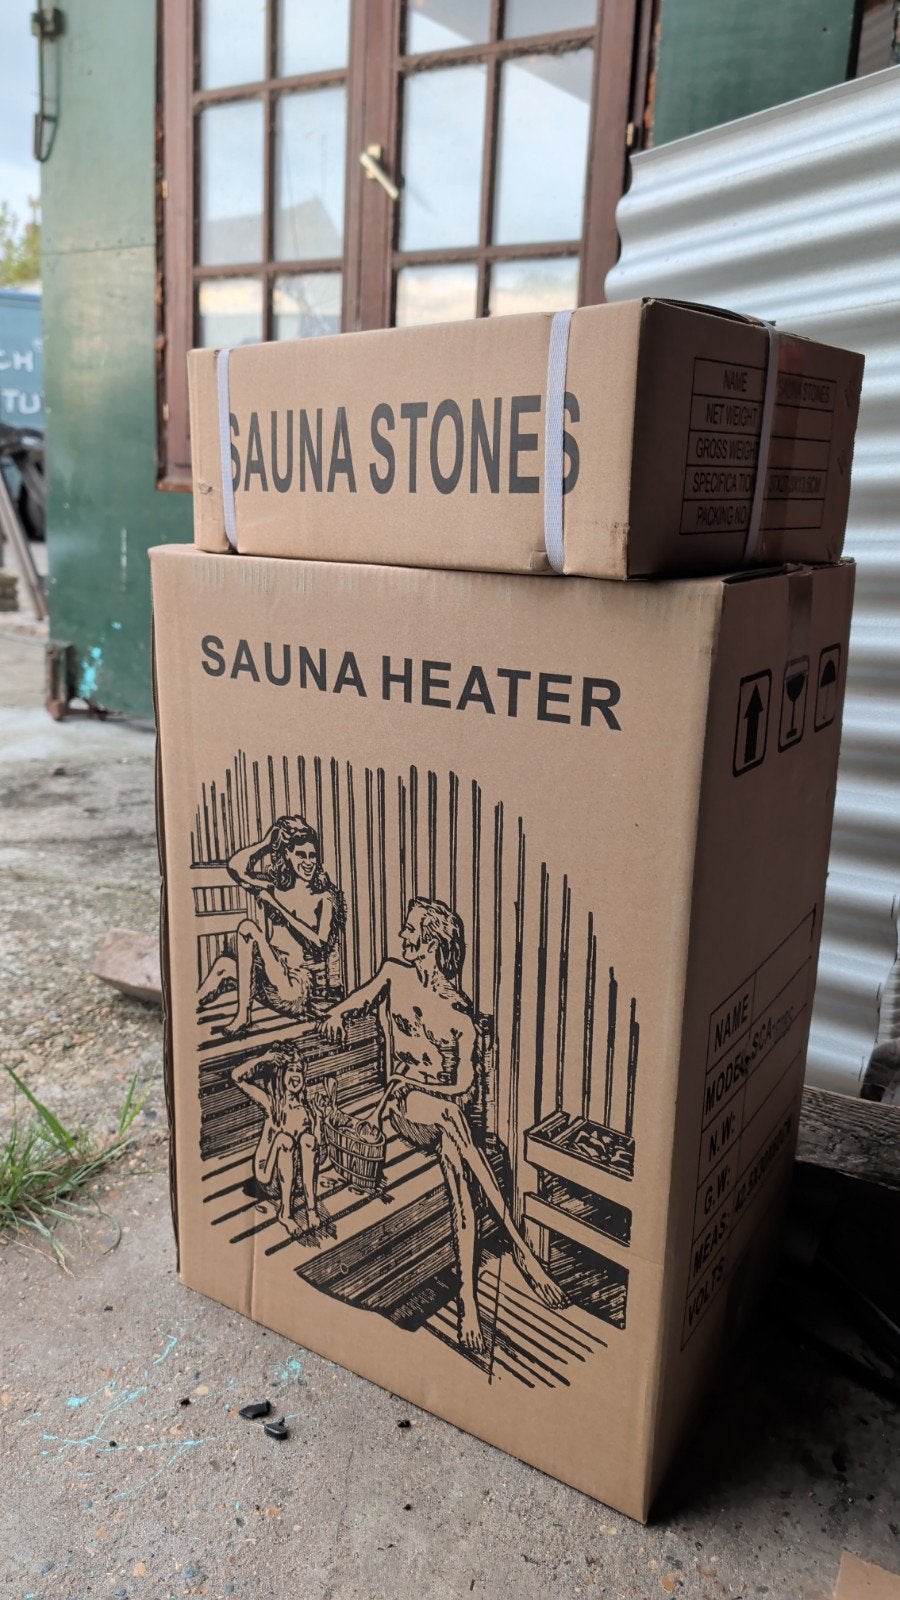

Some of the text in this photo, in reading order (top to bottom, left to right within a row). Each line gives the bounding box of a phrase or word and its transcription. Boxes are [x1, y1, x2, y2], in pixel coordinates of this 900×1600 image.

[723, 370, 748, 392] NAME
[706, 403, 758, 427] NET WEIGHT
[369, 391, 580, 494] STONES
[696, 438, 728, 460] GROSS
[697, 505, 734, 526] PACKING
[201, 635, 622, 731] SAUNA HEATER
[714, 993, 749, 1053] NAME
[688, 1257, 725, 1326] VOLTS
